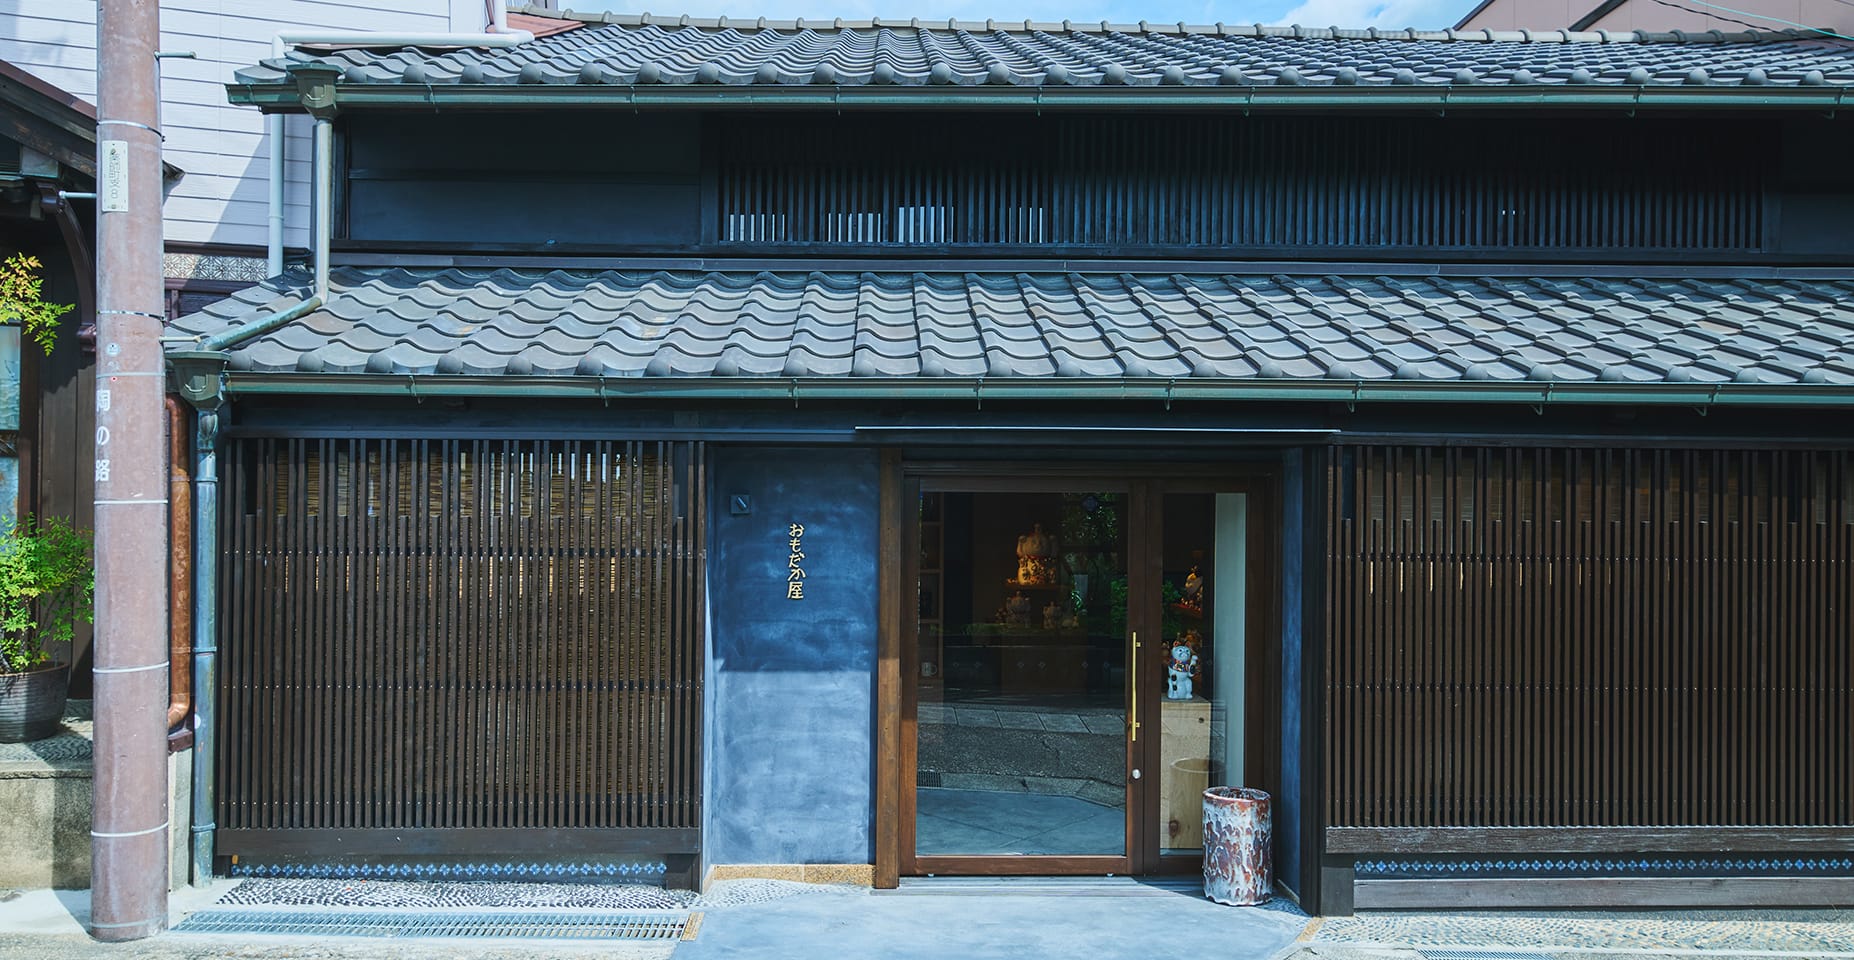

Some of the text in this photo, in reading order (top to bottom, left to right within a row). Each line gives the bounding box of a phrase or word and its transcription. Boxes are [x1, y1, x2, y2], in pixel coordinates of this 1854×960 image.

[787, 523, 806, 599] おもだか屋
